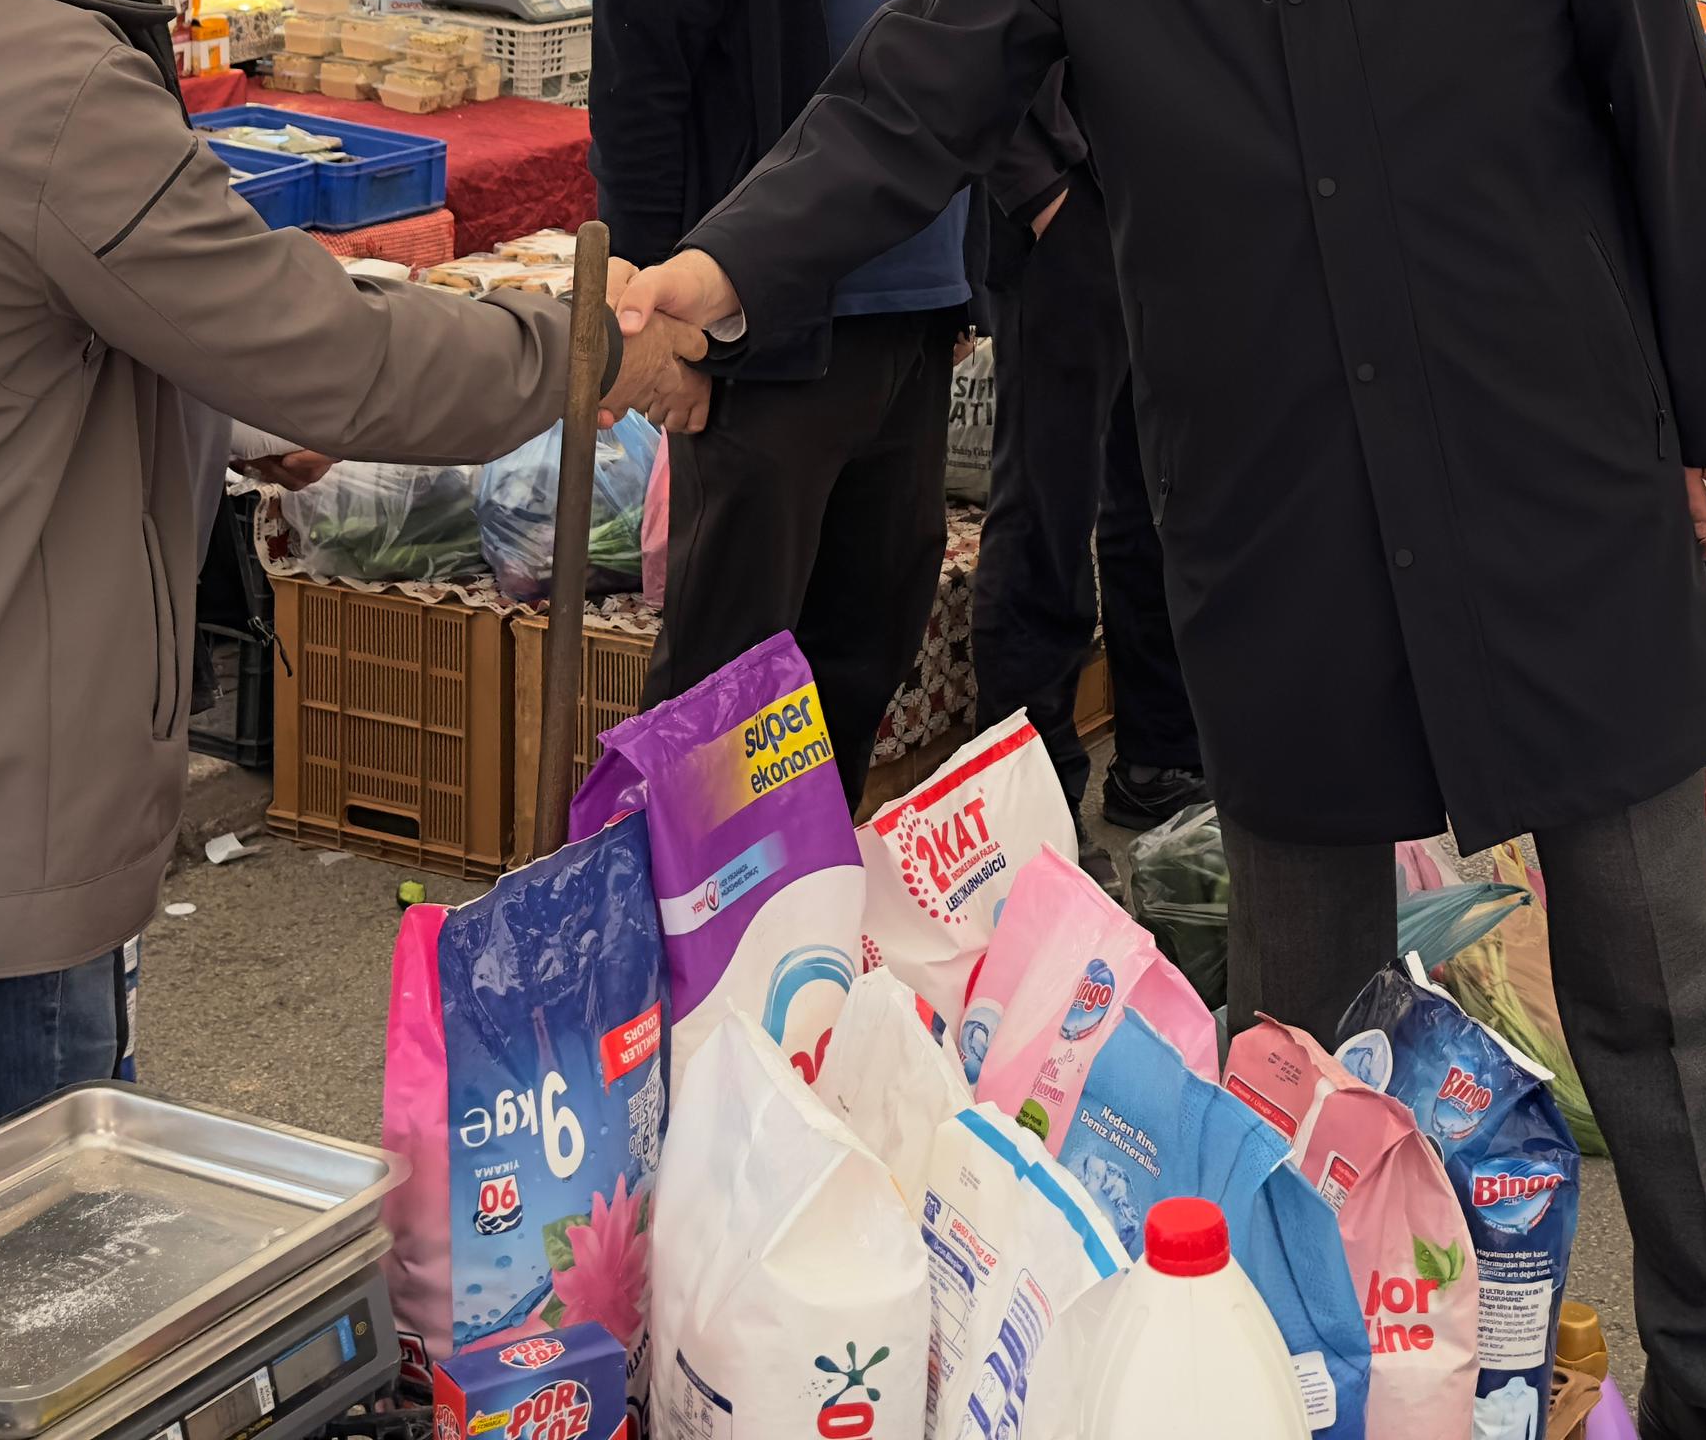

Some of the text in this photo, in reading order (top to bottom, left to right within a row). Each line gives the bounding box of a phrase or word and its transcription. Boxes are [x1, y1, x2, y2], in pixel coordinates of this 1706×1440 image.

[744, 694, 814, 759] süper
[750, 731, 831, 795] ekonomi
[981, 851, 1007, 881] GÜCÜ
[1077, 976, 1113, 1012] ingo
[623, 1013, 658, 1045] COLORS
[1438, 1065, 1492, 1115] Bingo
[1080, 1109, 1109, 1139] Deniz
[1101, 1106, 1135, 1138] Neden
[474, 1159, 521, 1179] YIKAMA
[480, 1177, 517, 1215] 90
[1472, 1173, 1565, 1207] Bingo
[499, 1337, 545, 1363] POR
[506, 1381, 578, 1440] POR
